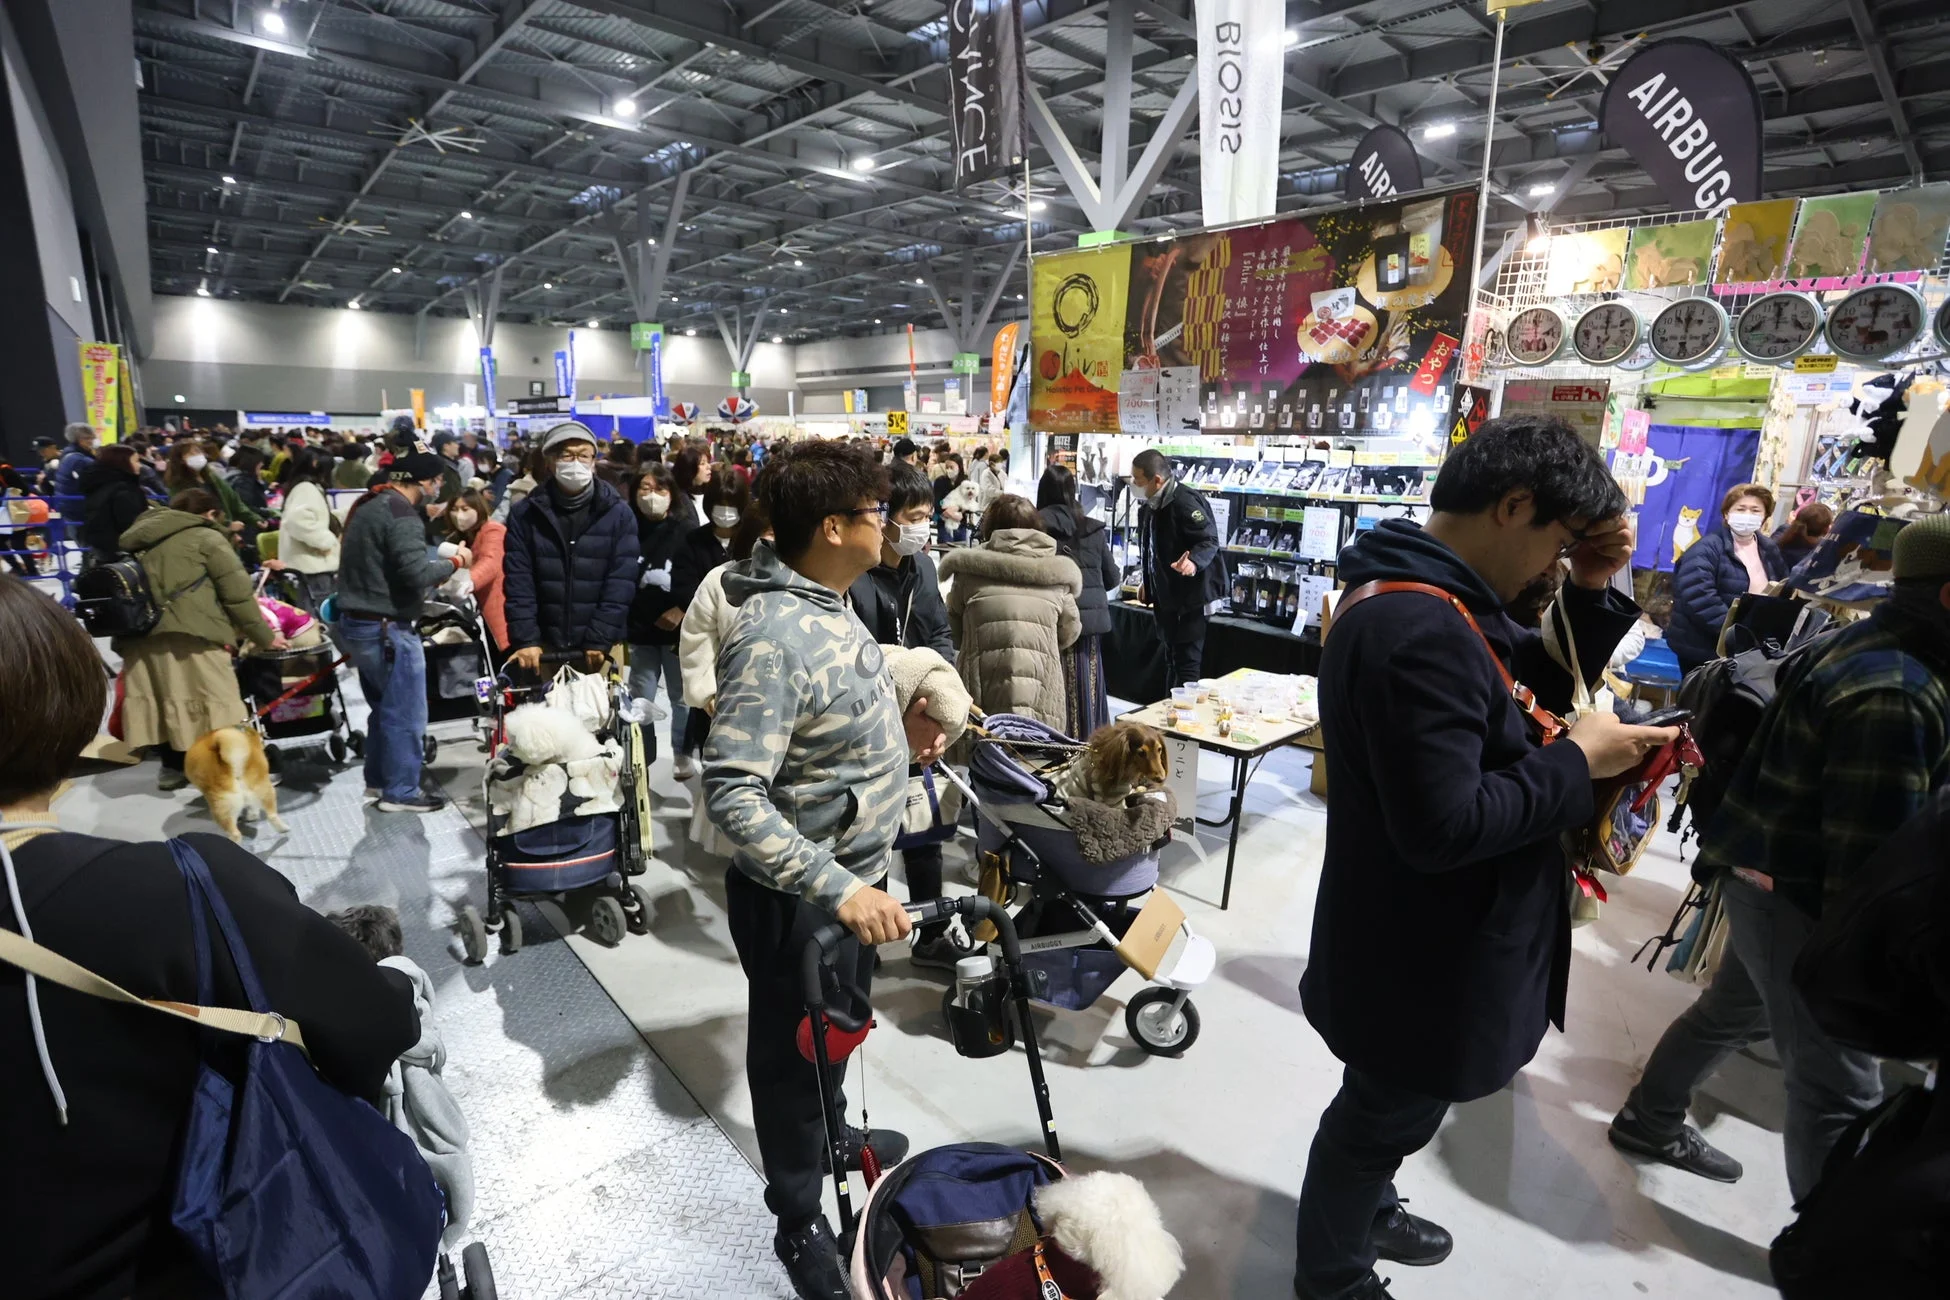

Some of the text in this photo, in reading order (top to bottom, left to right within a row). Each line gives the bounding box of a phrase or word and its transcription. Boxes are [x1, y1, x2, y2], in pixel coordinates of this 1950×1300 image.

[1421, 341, 1450, 385] おやつ
[1175, 742, 1186, 779] ワニと
[1031, 939, 1063, 951] AIRBUGGY
